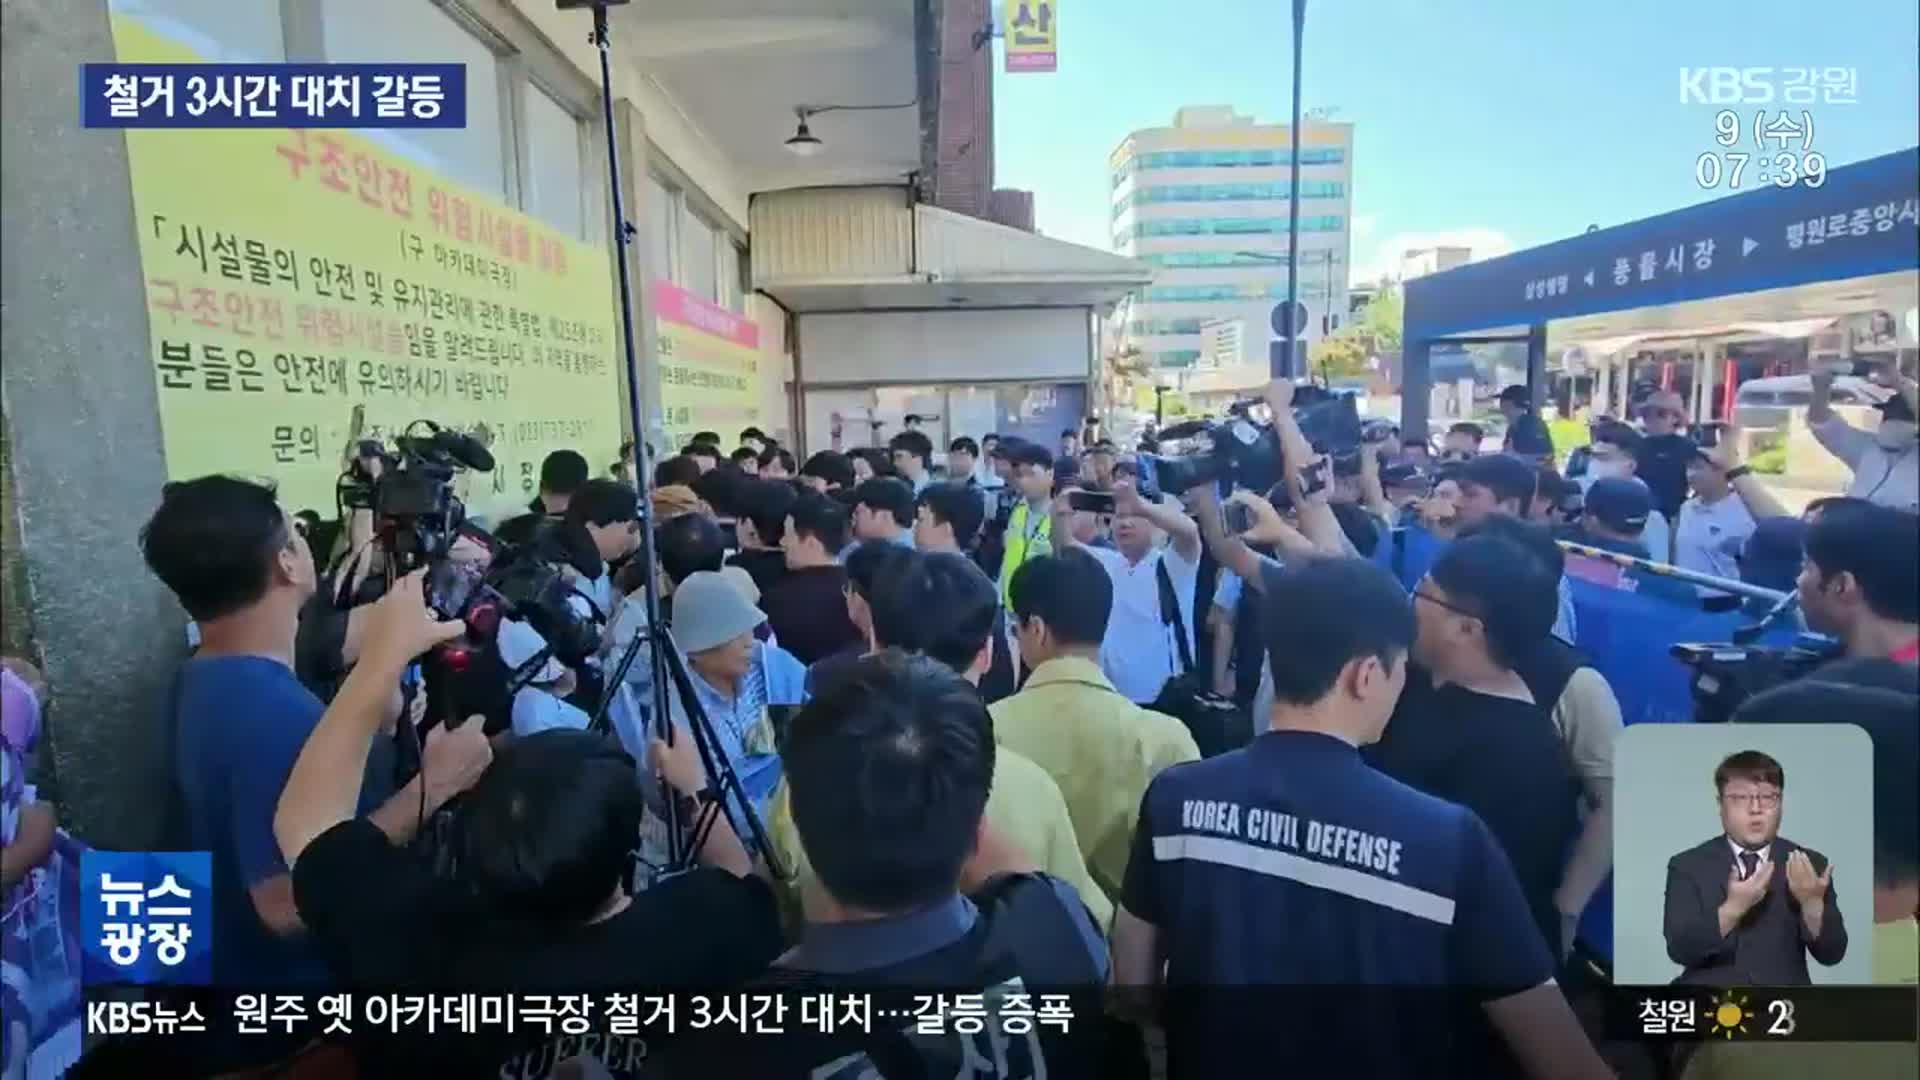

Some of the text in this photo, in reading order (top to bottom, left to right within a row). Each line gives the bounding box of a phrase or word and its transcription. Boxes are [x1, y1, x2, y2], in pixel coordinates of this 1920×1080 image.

[309, 257, 356, 301] 안전
[364, 270, 385, 307] 및
[158, 340, 264, 392] 분들은
[273, 353, 347, 395] 안전에
[358, 360, 449, 398] 유의하시기
[271, 425, 320, 464] 문의
[1182, 799, 1402, 876] KOREA CIVIL DEFENSE
